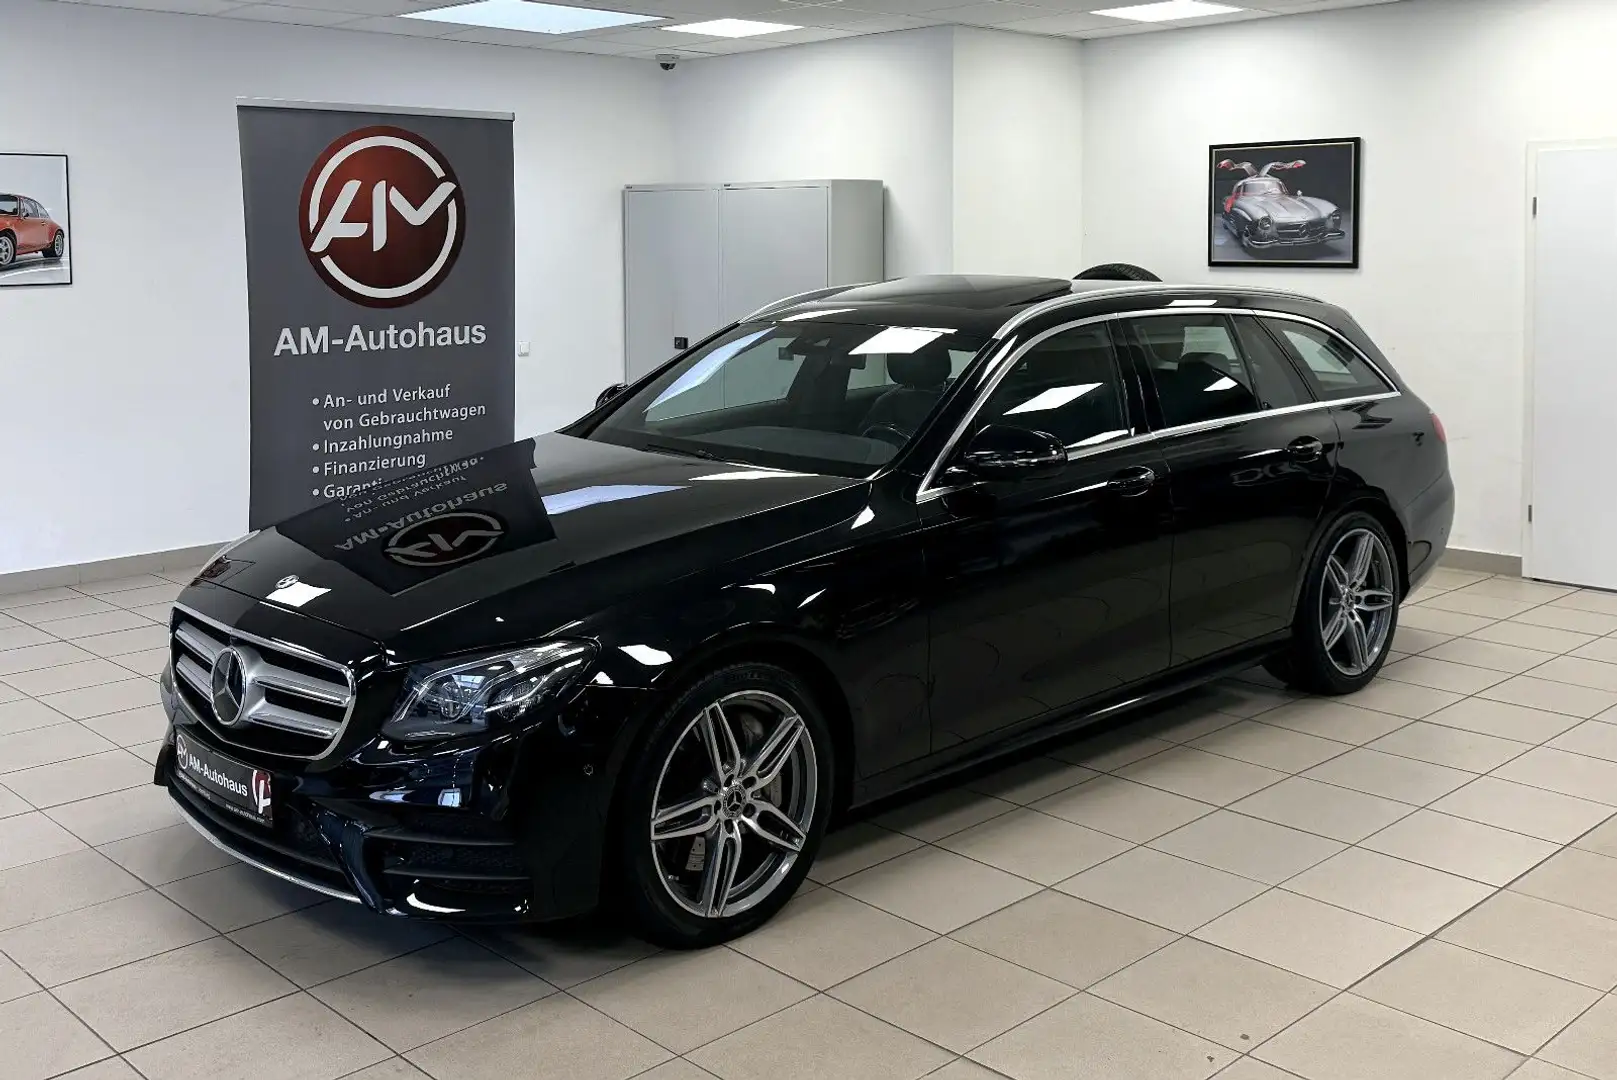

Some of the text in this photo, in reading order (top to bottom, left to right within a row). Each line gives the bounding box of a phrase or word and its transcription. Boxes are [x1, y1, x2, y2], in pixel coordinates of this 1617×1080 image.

[273, 321, 488, 357] AM-Autohaus
[323, 383, 451, 409] An- und Verkauf
[323, 403, 487, 431] von Gebrauchtwagen
[323, 428, 454, 454] Inzahlungnahme
[323, 452, 427, 477] Finanzierung
[188, 753, 248, 797] AM-Autohaus
